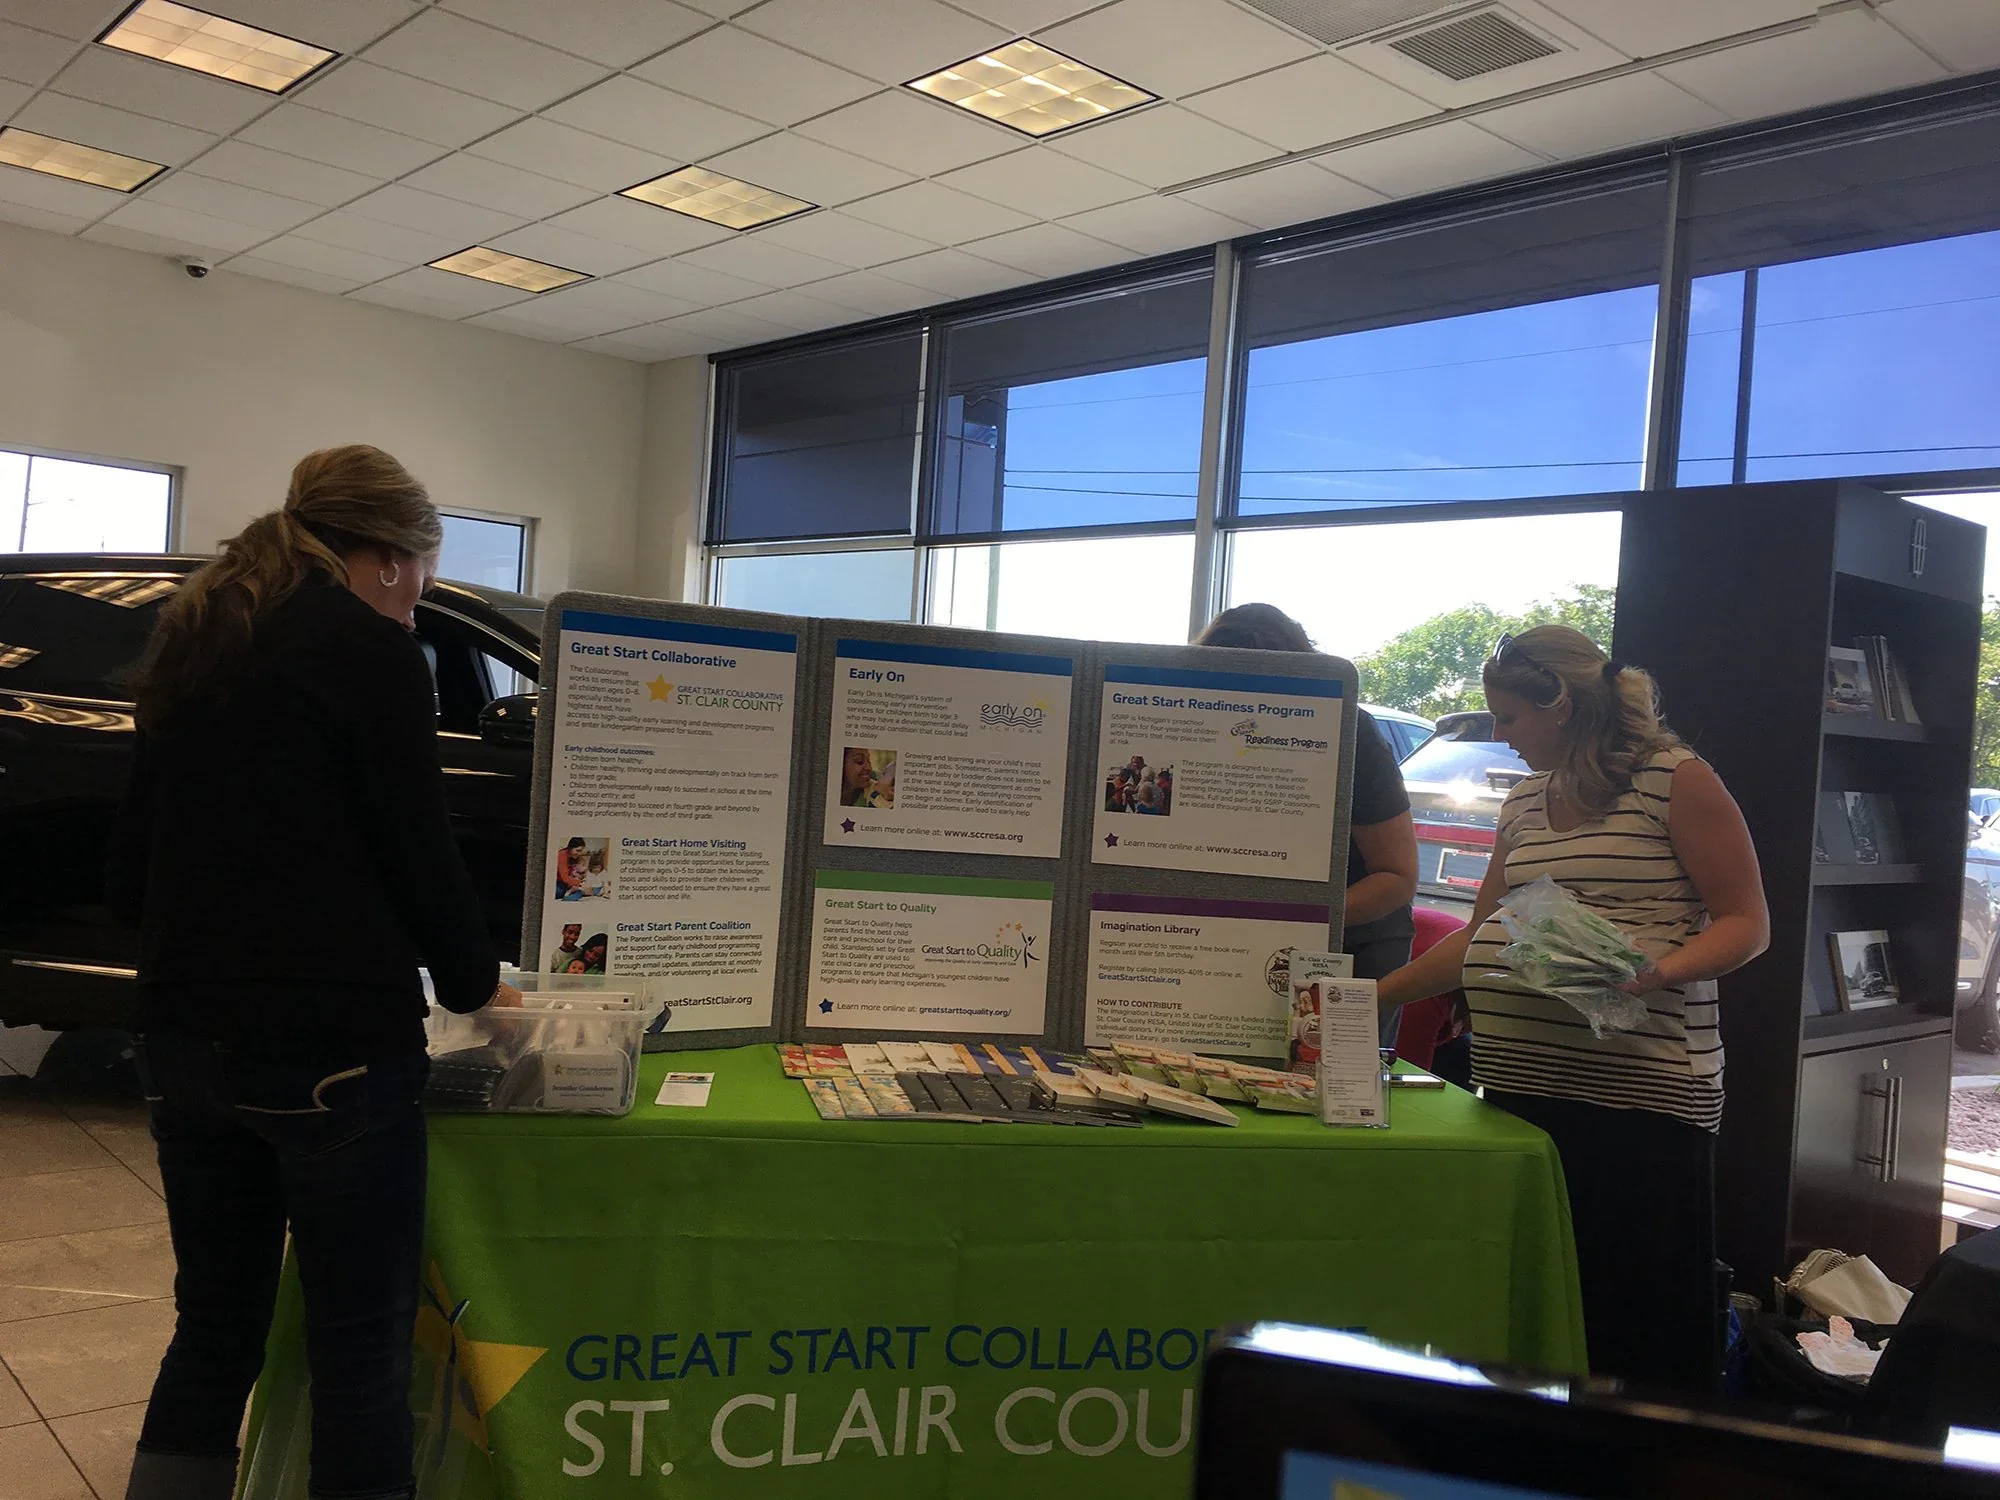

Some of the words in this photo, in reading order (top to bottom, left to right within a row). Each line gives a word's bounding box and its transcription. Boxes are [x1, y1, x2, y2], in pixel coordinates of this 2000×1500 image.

[571, 642, 609, 656] Great
[613, 646, 648, 660] Start
[652, 649, 736, 668] Collaborative
[850, 668, 883, 684] Early
[886, 670, 905, 683] On
[677, 686, 701, 695] GREAT
[702, 688, 725, 696] START
[726, 689, 784, 700] COLLABORATIVE
[677, 694, 692, 706] ST.
[695, 696, 729, 708] CLAIR
[732, 699, 782, 713] COUNTY
[1113, 693, 1148, 706] Great
[1152, 695, 1184, 708] Start
[1188, 698, 1254, 713] Readiness
[1258, 703, 1314, 720] Program
[981, 703, 1018, 722] early
[1023, 707, 1042, 717] on
[980, 725, 1042, 734] MICHIGAN
[1244, 734, 1288, 746] Readiness
[1290, 737, 1328, 748] Program
[564, 744, 583, 754] Early
[584, 745, 619, 754] childhood
[860, 823, 883, 833] Learn
[907, 825, 930, 836] online
[932, 828, 942, 836] at:
[944, 830, 1023, 843] www.sccresa.org
[622, 838, 650, 847] Great
[652, 838, 678, 848] Start
[680, 838, 708, 848] Home
[710, 839, 746, 851] Visiting
[1124, 838, 1145, 848] Learn
[1169, 841, 1192, 852] online
[1194, 844, 1204, 852] at:
[1206, 846, 1287, 861] www.sccresa.org
[825, 899, 854, 910] Great
[857, 901, 884, 911] Start
[886, 903, 897, 911] to
[900, 902, 937, 915] Quality
[616, 922, 645, 932] Great
[647, 922, 672, 931] Start
[674, 921, 707, 931] Parent
[709, 921, 751, 930] Coalition
[823, 927, 849, 936] parents
[870, 920, 894, 930] Quality
[895, 920, 912, 930] helps
[1100, 920, 1161, 935] Imagination
[1164, 923, 1200, 937] Library
[630, 944, 656, 953] support
[668, 943, 685, 952] early
[686, 942, 717, 950] childhood
[718, 942, 760, 951] programming
[853, 935, 885, 946] preschool
[714, 951, 729, 960] stay
[729, 949, 763, 957] connected
[841, 943, 875, 952] Standards
[887, 945, 896, 954] by
[897, 945, 916, 953] Great
[922, 944, 944, 954] Great
[946, 946, 966, 956] Start
[967, 948, 975, 956] to
[976, 944, 1023, 962] Quality
[848, 952, 872, 962] Quality
[664, 995, 752, 1008] reatStartStClair.org
[1097, 998, 1117, 1006] HOW
[1131, 1000, 1182, 1010] CONTRIBUTE
[837, 1001, 859, 1010] Learn
[882, 1003, 905, 1012] online
[919, 1005, 1012, 1018] greatstarttoquality.org/
[565, 1331, 752, 1382] GREAT
[768, 1327, 930, 1374] START
[945, 1325, 1210, 1372] COLLABO
[562, 1400, 674, 1478] ST.
[708, 1386, 964, 1468] CLAIR
[994, 1388, 1193, 1459] COU
